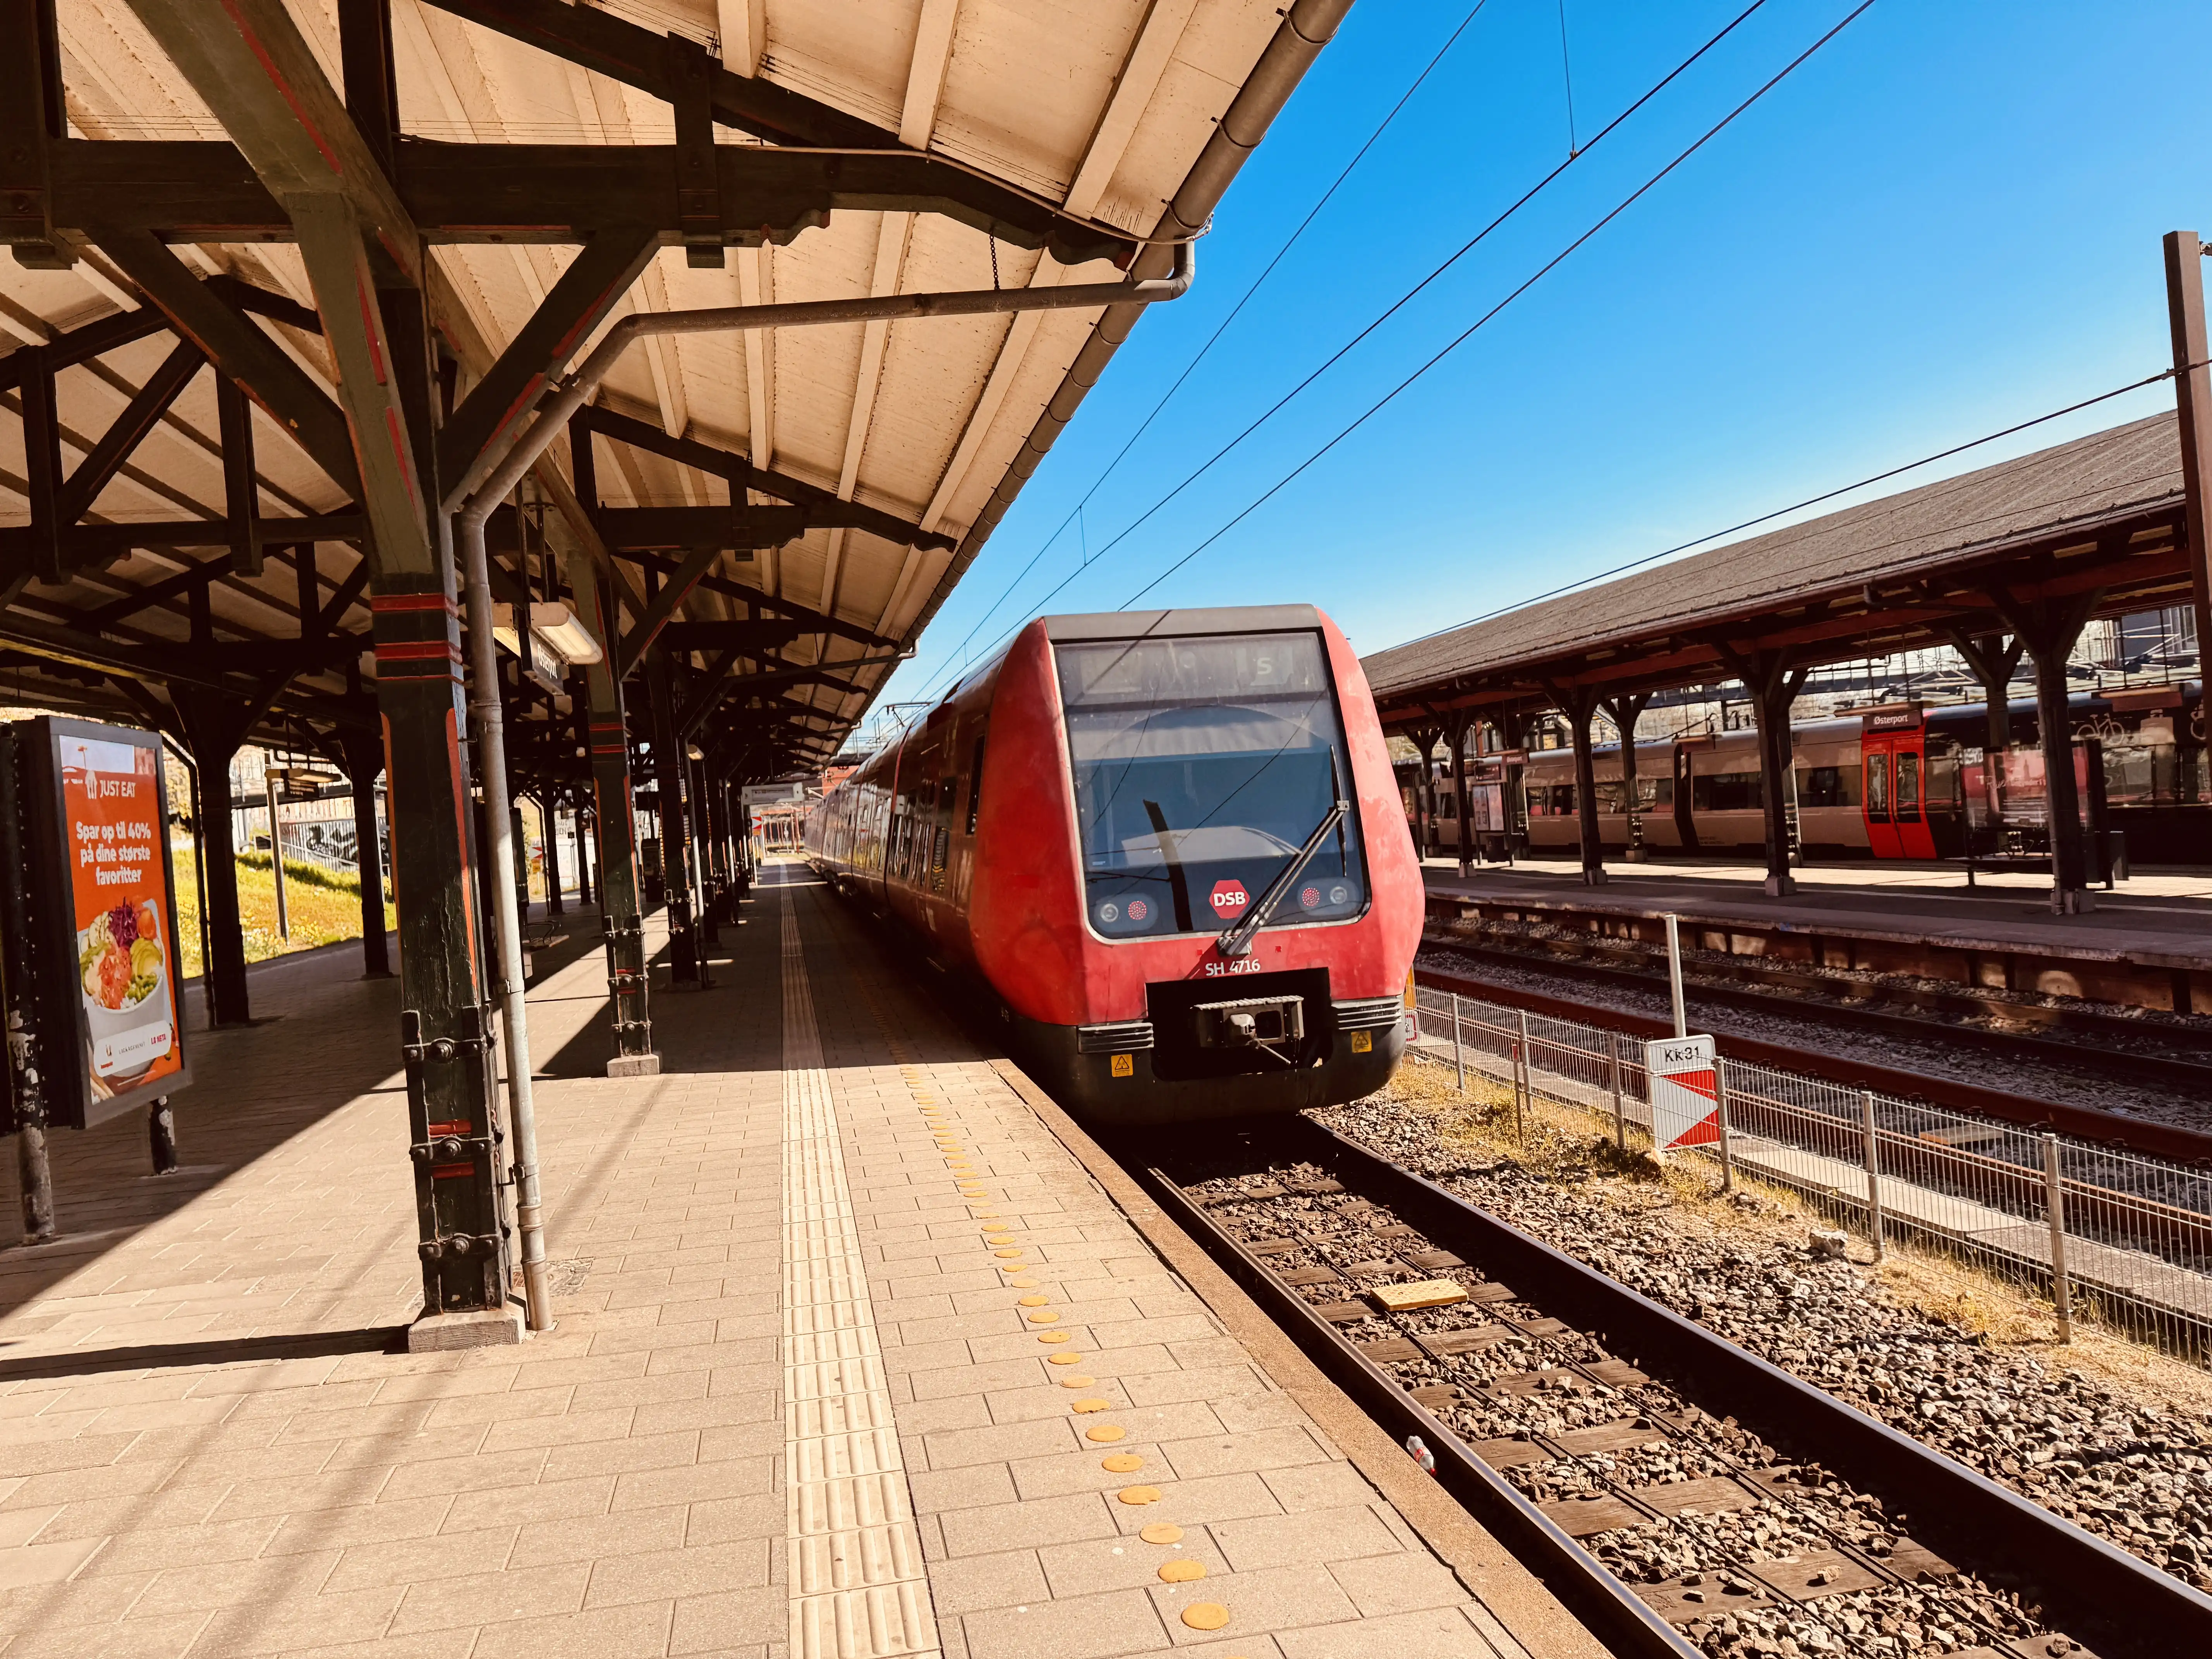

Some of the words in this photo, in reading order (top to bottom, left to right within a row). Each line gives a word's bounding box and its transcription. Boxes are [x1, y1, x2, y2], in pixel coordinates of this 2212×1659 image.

[1874, 714, 1908, 725] Østerport
[100, 780, 120, 798] JUST
[121, 781, 136, 798] EAT
[76, 821, 100, 844] Spar
[101, 825, 114, 844] op
[116, 821, 126, 840] til
[128, 822, 151, 840] 40%
[80, 842, 94, 867] på
[96, 843, 117, 862] dine
[118, 844, 151, 862] største
[96, 865, 142, 886] favoritter
[1213, 891, 1246, 907] DSB
[1205, 962, 1224, 976] SH
[1229, 958, 1261, 974] 4716
